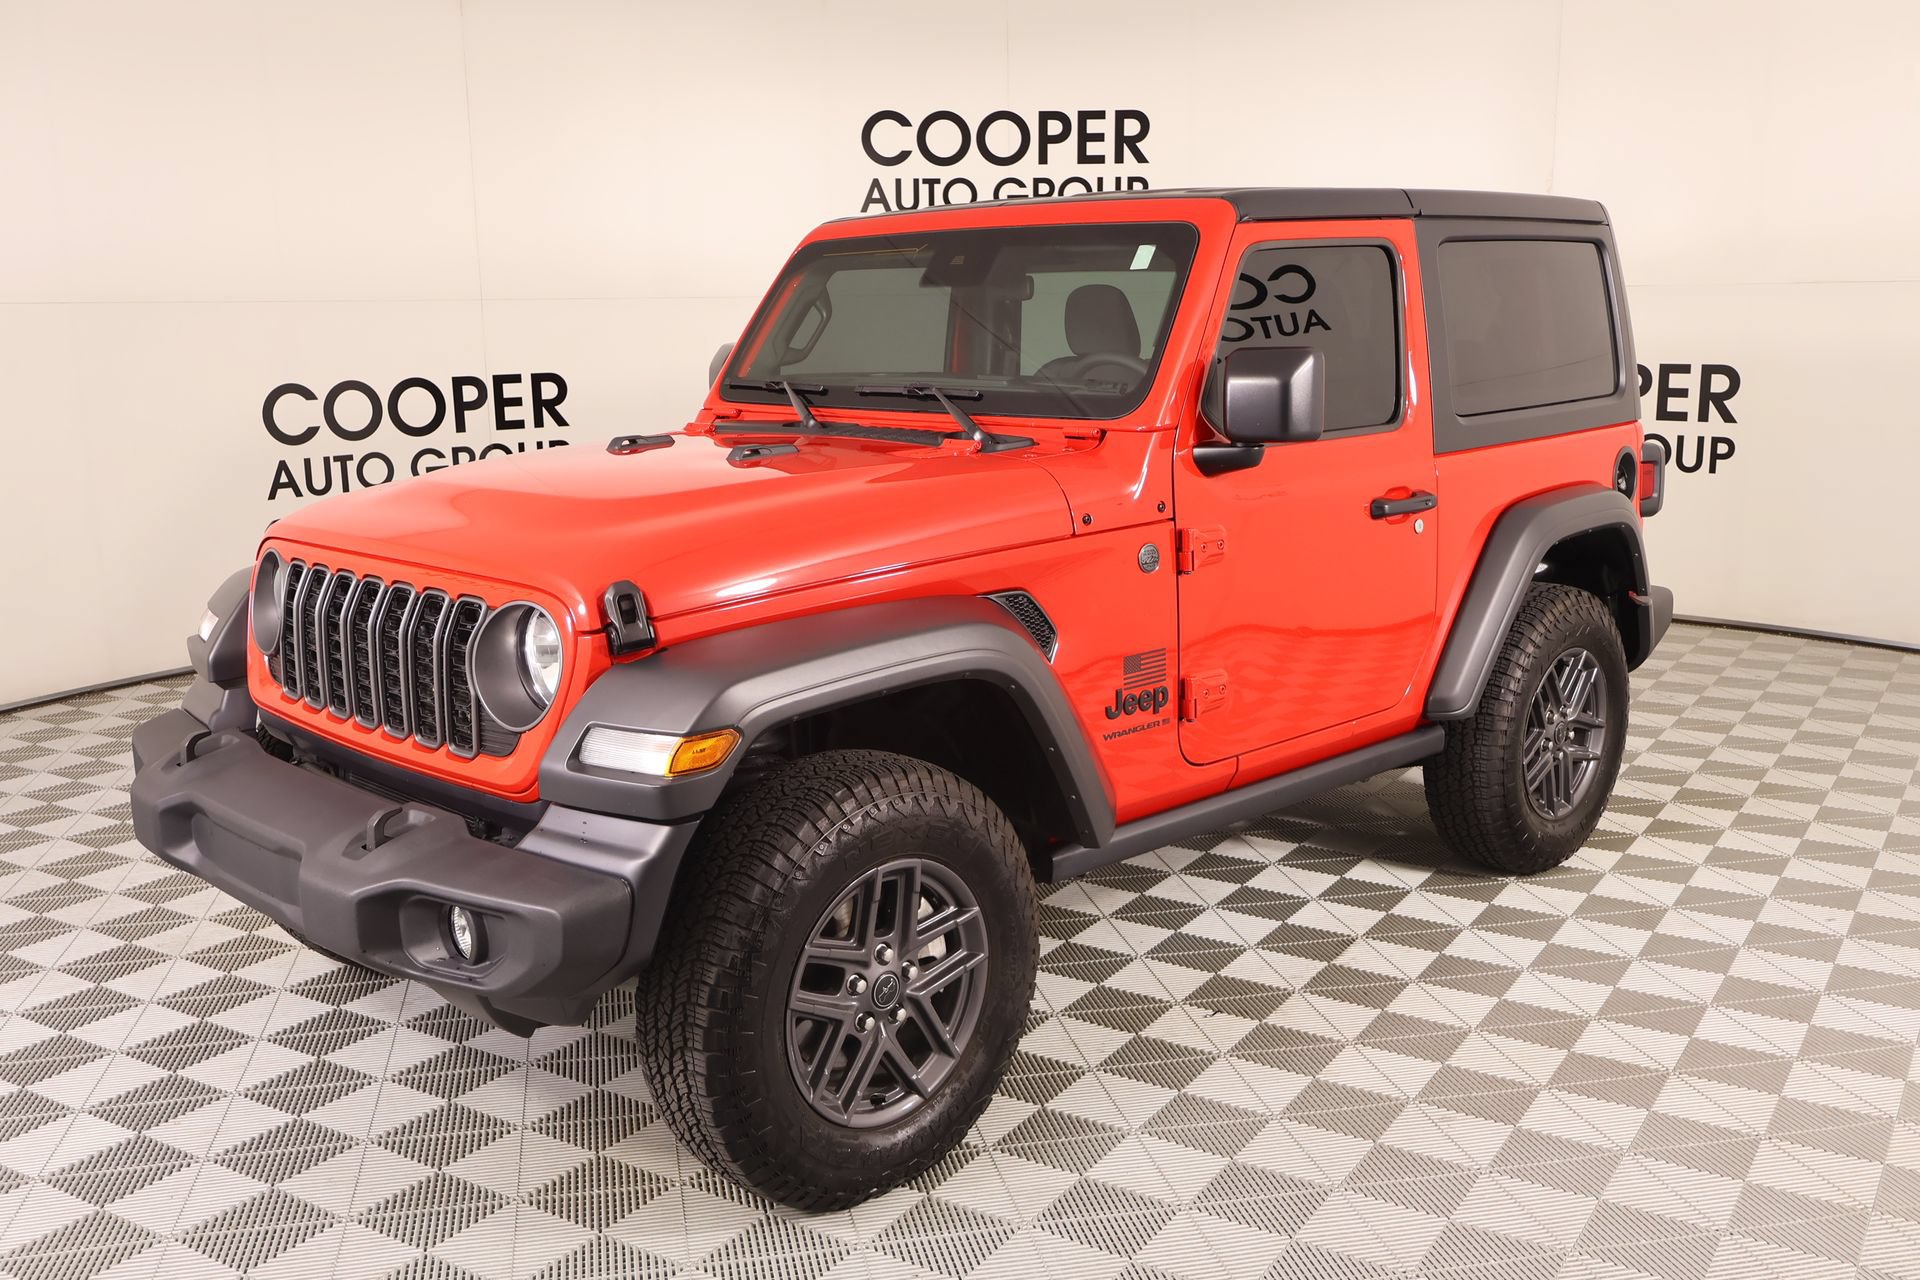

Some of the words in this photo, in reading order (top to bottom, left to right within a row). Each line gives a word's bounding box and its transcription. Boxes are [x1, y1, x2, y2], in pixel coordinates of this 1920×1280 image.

[861, 109, 1150, 167] COOPER
[860, 177, 978, 213] AUTO
[262, 372, 570, 446] COOPER
[267, 451, 395, 500] AUTO
[1105, 686, 1169, 720] Jeep
[1103, 719, 1161, 741] WRANGLER
